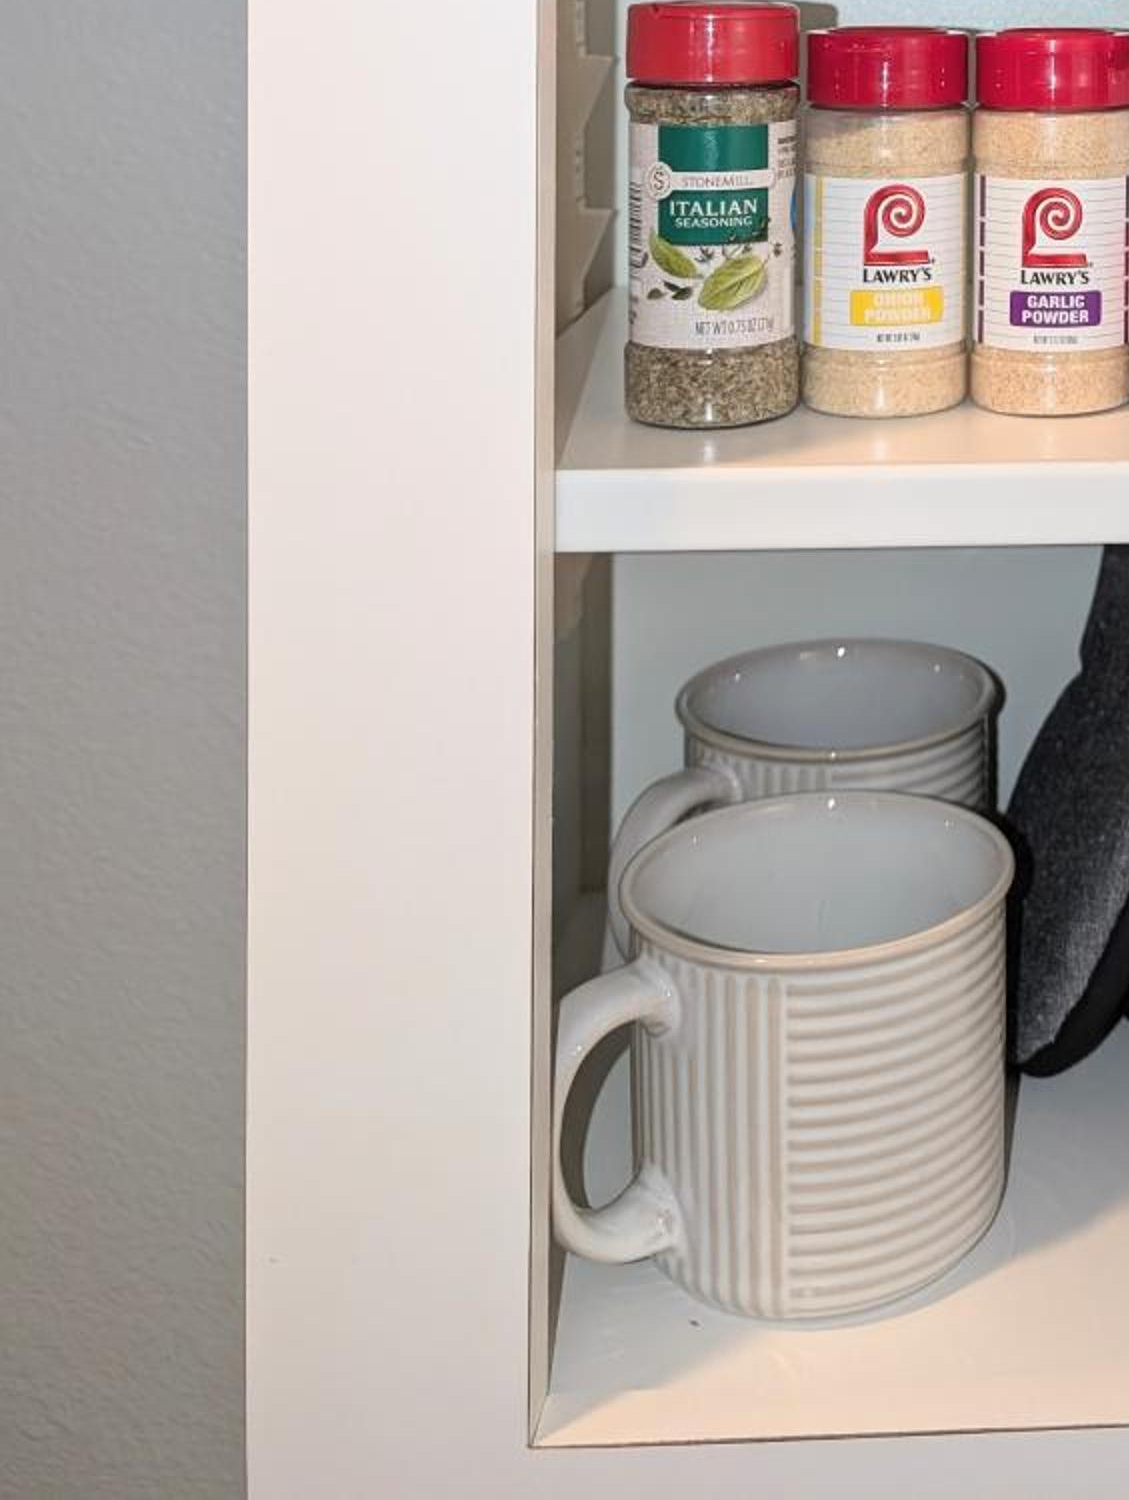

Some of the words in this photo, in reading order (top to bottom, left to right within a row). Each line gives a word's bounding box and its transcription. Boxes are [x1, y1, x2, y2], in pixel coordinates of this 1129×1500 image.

[669, 198, 757, 217] ITALIAN
[674, 215, 753, 229] SEASONING
[863, 267, 932, 283] LAWRY'S
[1021, 269, 1090, 285] LAWRY'S
[1027, 294, 1086, 309] GARLIC
[1021, 309, 1089, 325] POWDER
